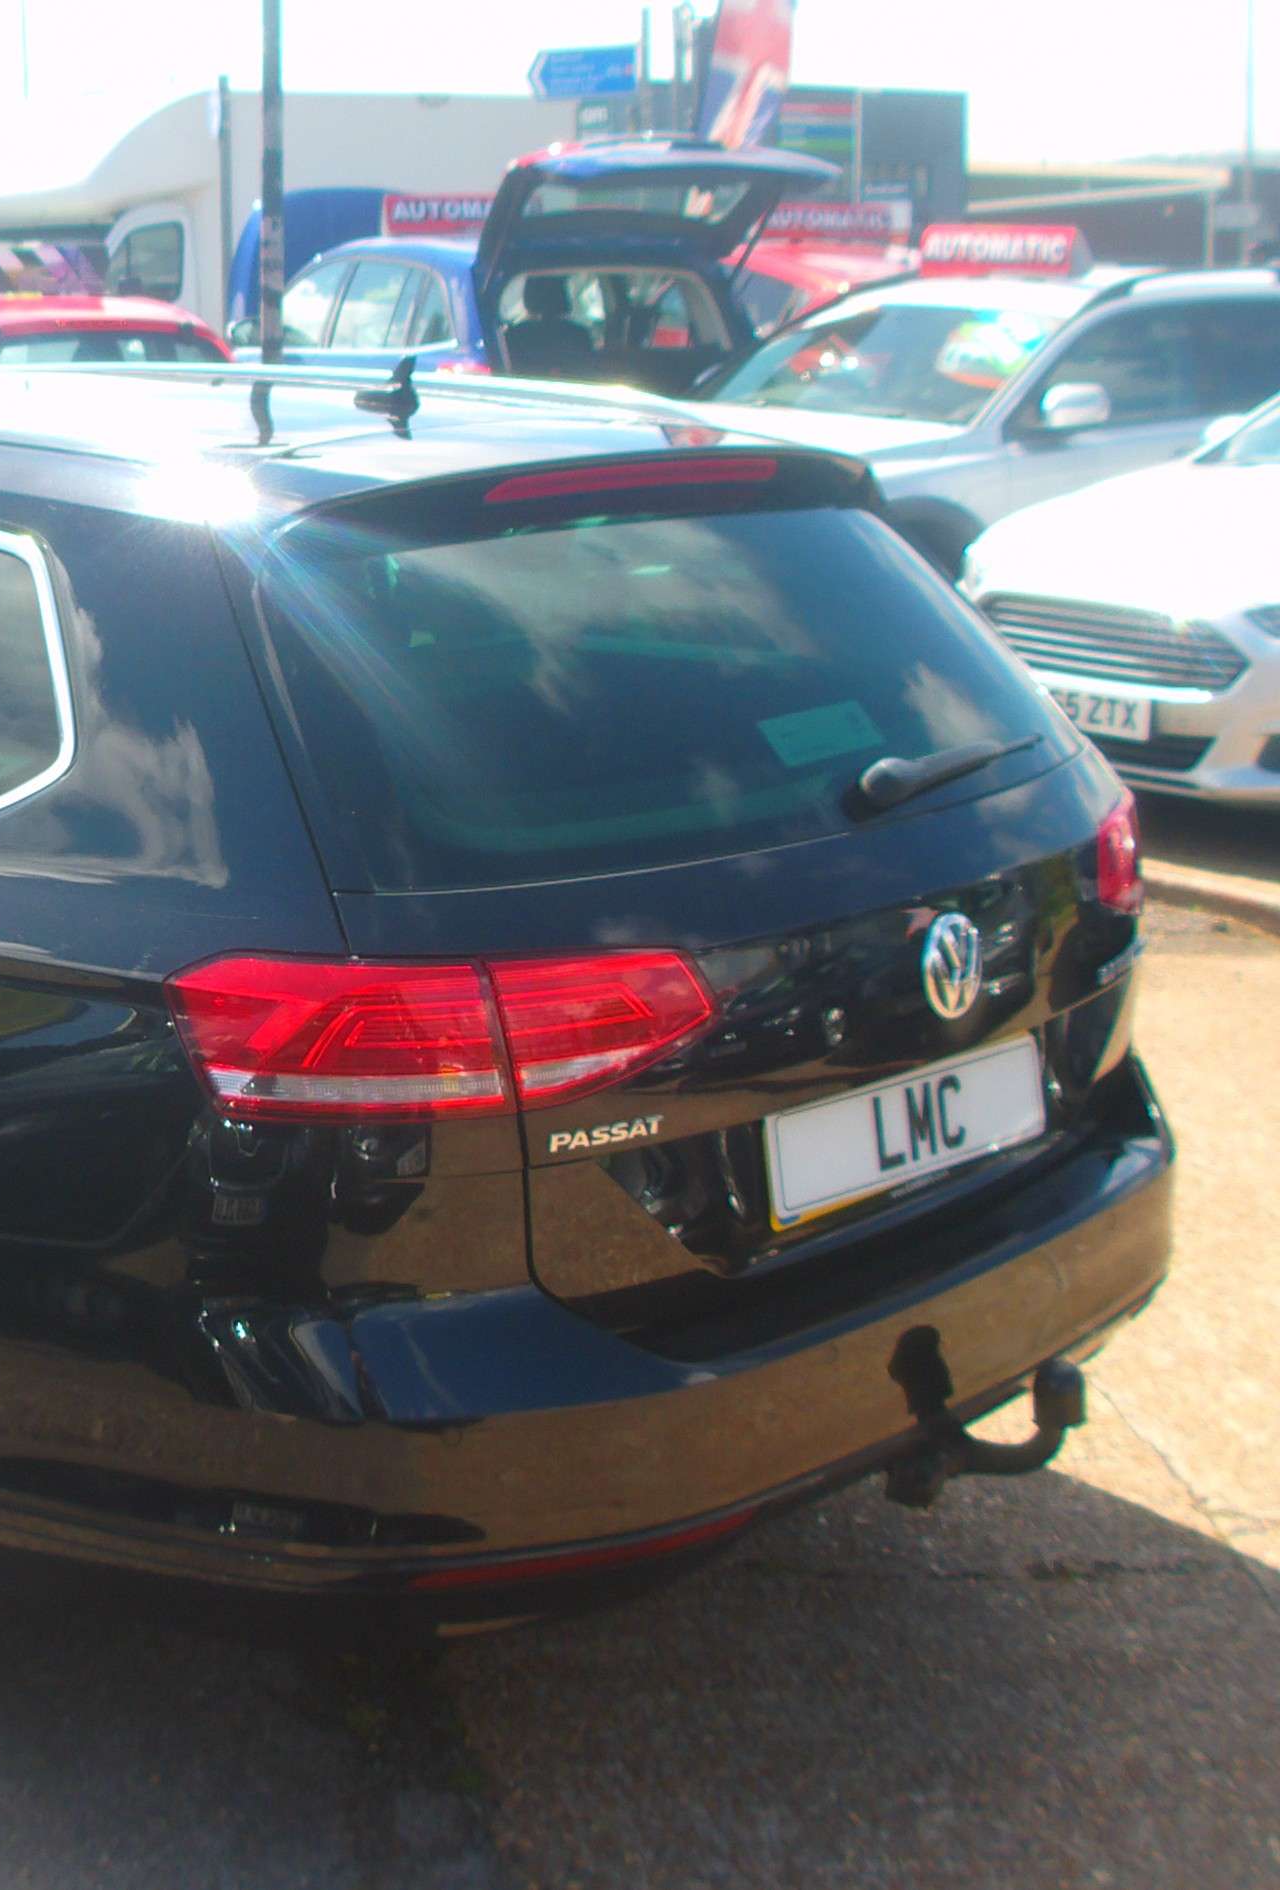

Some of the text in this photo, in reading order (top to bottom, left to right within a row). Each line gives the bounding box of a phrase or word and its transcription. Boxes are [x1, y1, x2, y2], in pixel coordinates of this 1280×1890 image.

[925, 232, 1067, 263] AUTOMATIC
[1087, 695, 1137, 731] ZTX
[549, 1114, 663, 1153] PASSAT
[873, 1074, 966, 1171] LMC
